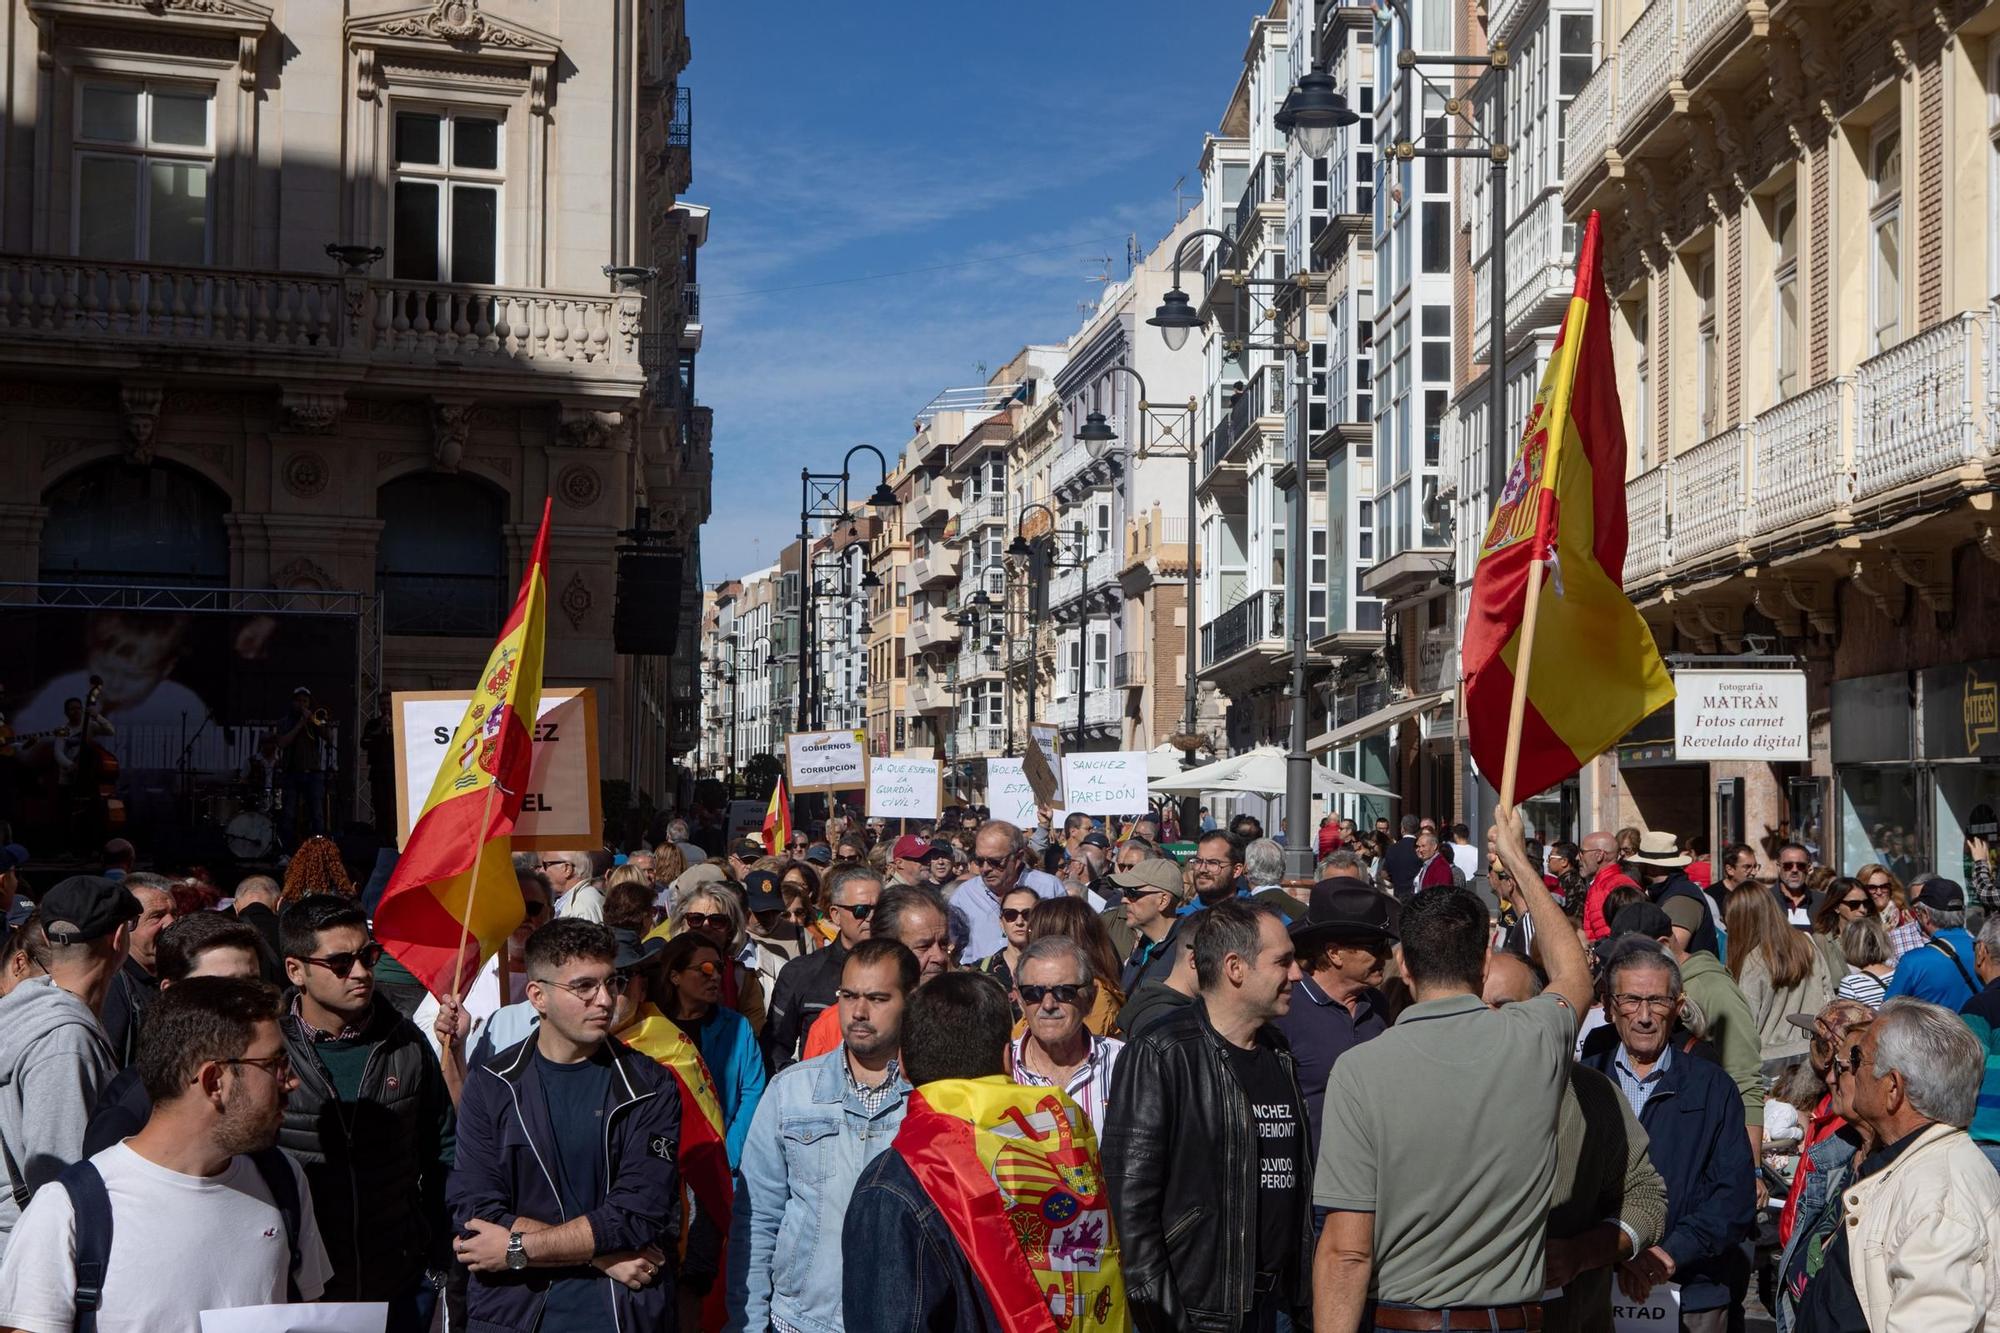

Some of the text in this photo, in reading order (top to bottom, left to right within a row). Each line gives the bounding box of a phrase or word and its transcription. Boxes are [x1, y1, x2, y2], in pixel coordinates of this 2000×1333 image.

[1703, 692, 1779, 709] MATRÁN
[1695, 715, 1785, 727] Fotos carnet
[801, 743, 852, 753] GOBIERNOS
[1682, 735, 1750, 748] Revelado
[1753, 735, 1802, 752] digital
[1073, 760, 1127, 769] SANCHEZ
[1088, 774, 1106, 784] AL
